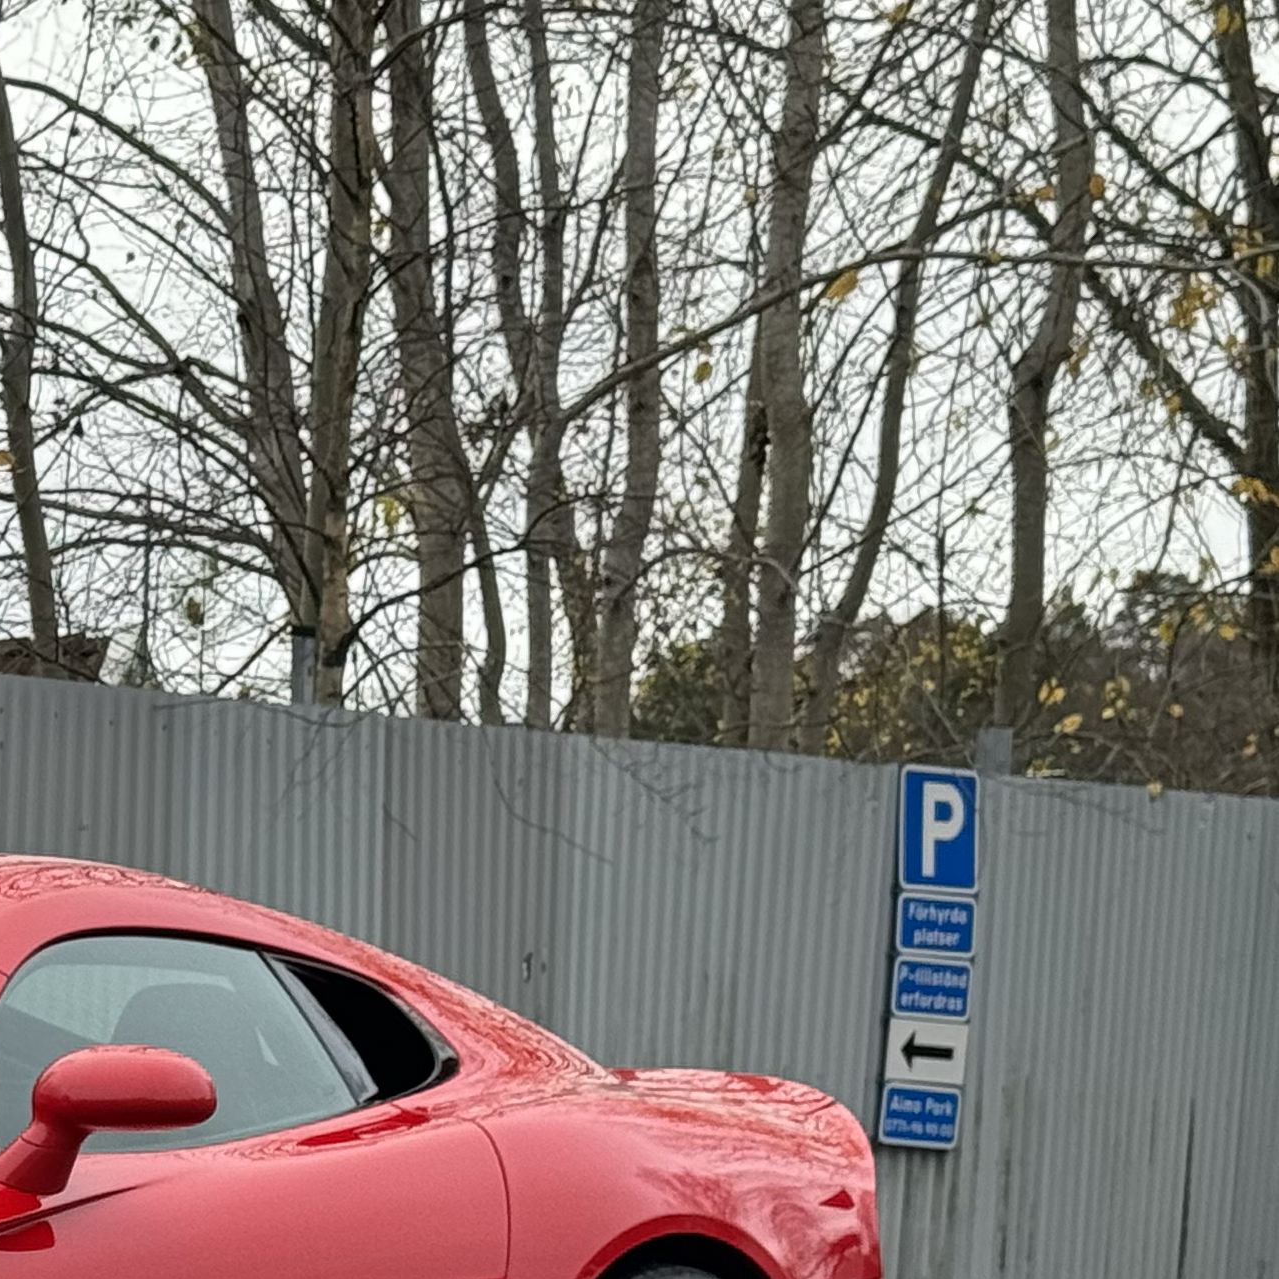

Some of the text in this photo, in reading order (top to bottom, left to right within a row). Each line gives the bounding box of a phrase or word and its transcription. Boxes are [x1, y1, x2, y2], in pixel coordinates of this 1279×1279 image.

[922, 781, 964, 877] P
[908, 902, 967, 926] Förhyrda
[914, 928, 960, 947] platser
[899, 965, 967, 988] P-tillstånd
[901, 990, 963, 1012] erfordras
[925, 1097, 954, 1117] Park
